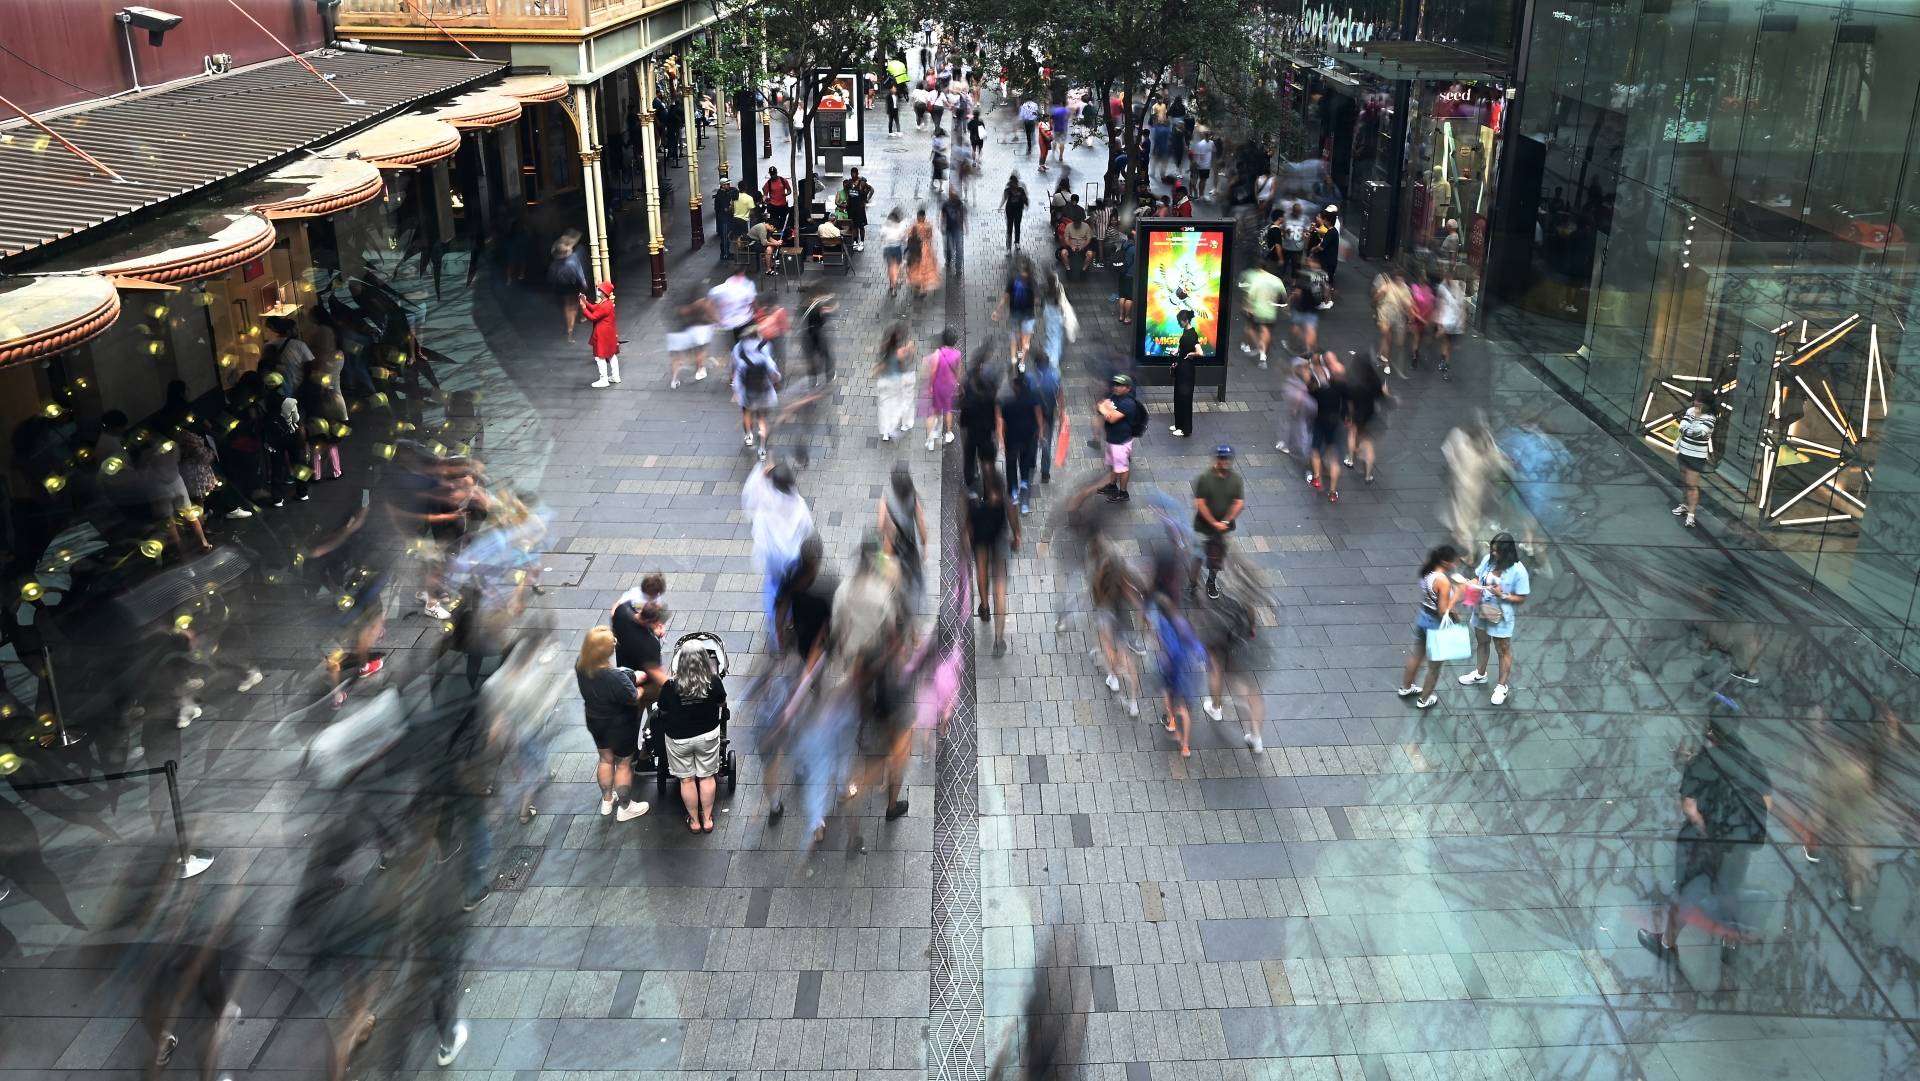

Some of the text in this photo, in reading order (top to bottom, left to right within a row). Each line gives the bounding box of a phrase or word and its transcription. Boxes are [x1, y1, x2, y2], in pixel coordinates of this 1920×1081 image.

[1440, 88, 1471, 101] seed
[1154, 336, 1208, 346] MIGRN
[1736, 341, 1764, 460] SALE
